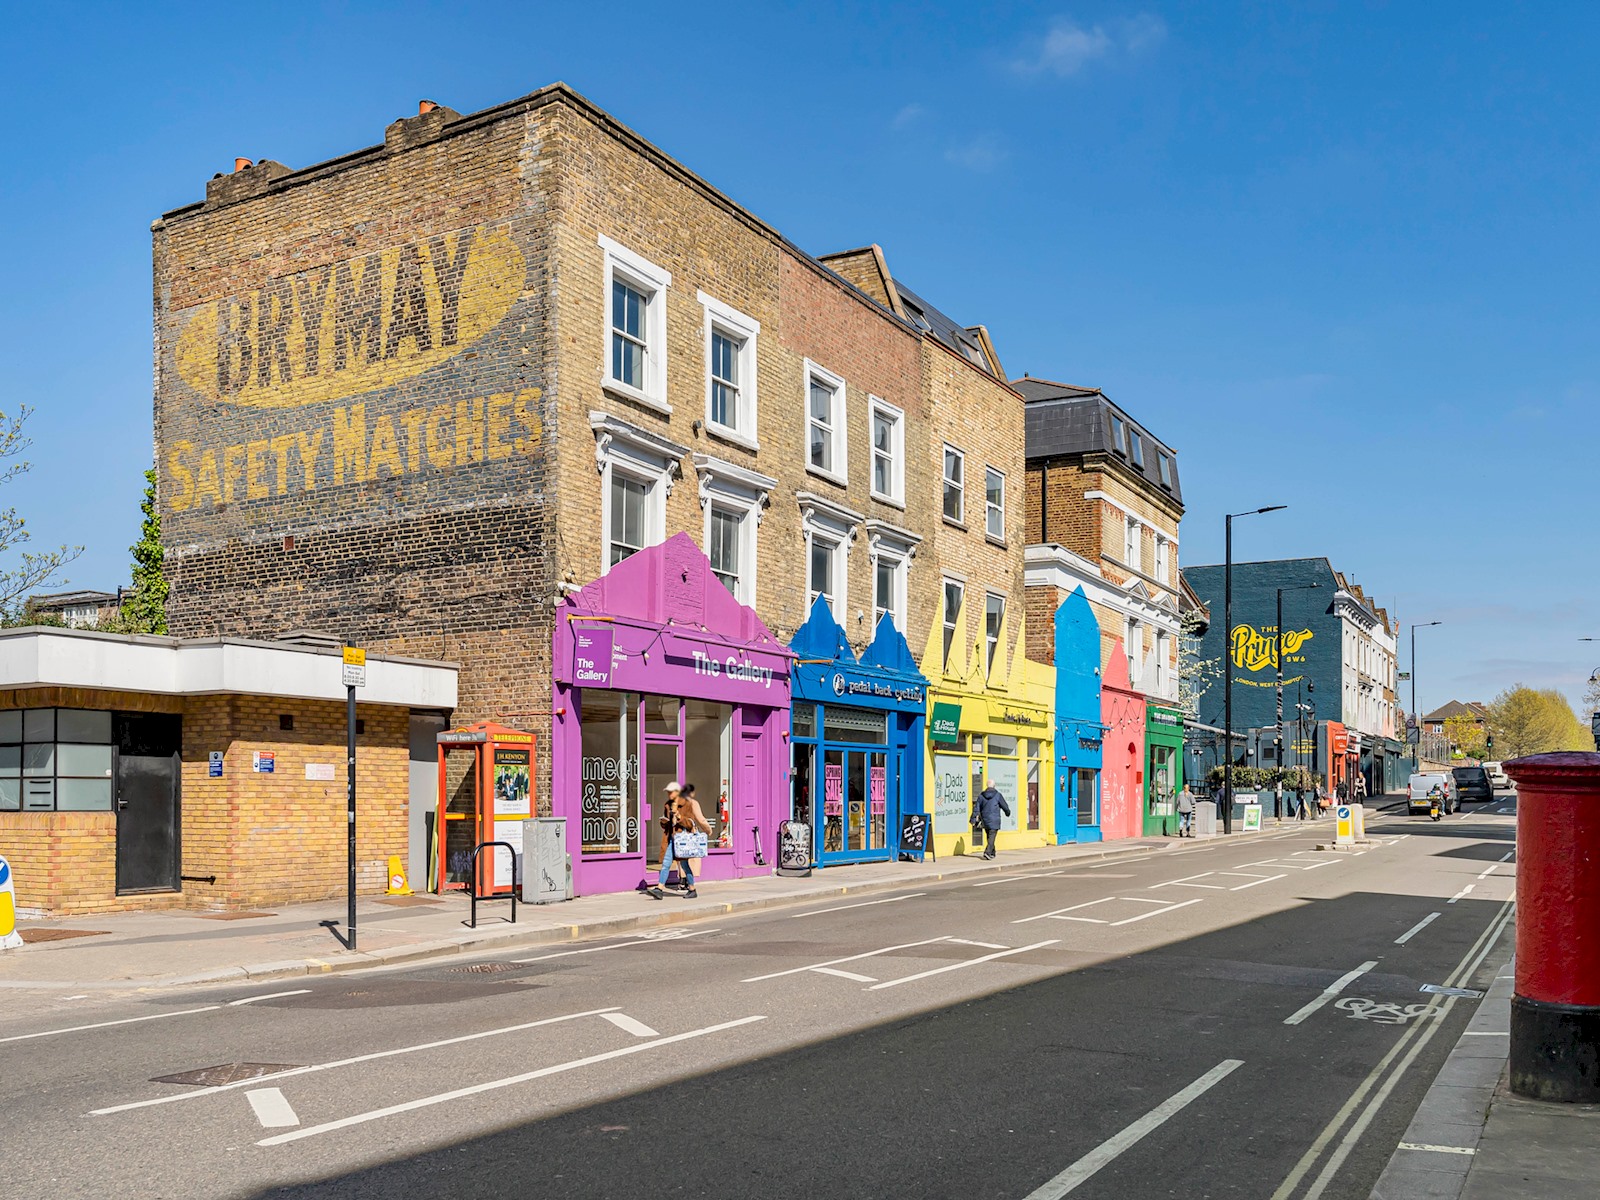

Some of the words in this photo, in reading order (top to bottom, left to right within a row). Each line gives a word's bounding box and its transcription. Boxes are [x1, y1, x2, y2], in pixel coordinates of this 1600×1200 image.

[167, 428, 322, 511] SAFETY
[334, 387, 543, 485] MATCHES
[1230, 624, 1314, 672] Prince
[577, 658, 594, 669] The
[692, 650, 721, 677] The
[725, 656, 774, 689] Gallery
[576, 669, 608, 683] Gallery
[849, 681, 872, 694] pedal
[874, 683, 892, 696] back
[894, 687, 923, 702] cycling
[497, 734, 529, 742] TELEPHONE
[582, 754, 638, 781] meet
[826, 767, 842, 778] SPRING
[871, 768, 885, 779] SPRING
[825, 779, 842, 801] SALE
[871, 780, 885, 801] SALE
[945, 773, 963, 789] Dads
[582, 783, 600, 814] &
[944, 789, 966, 804] House
[582, 816, 639, 841] more
